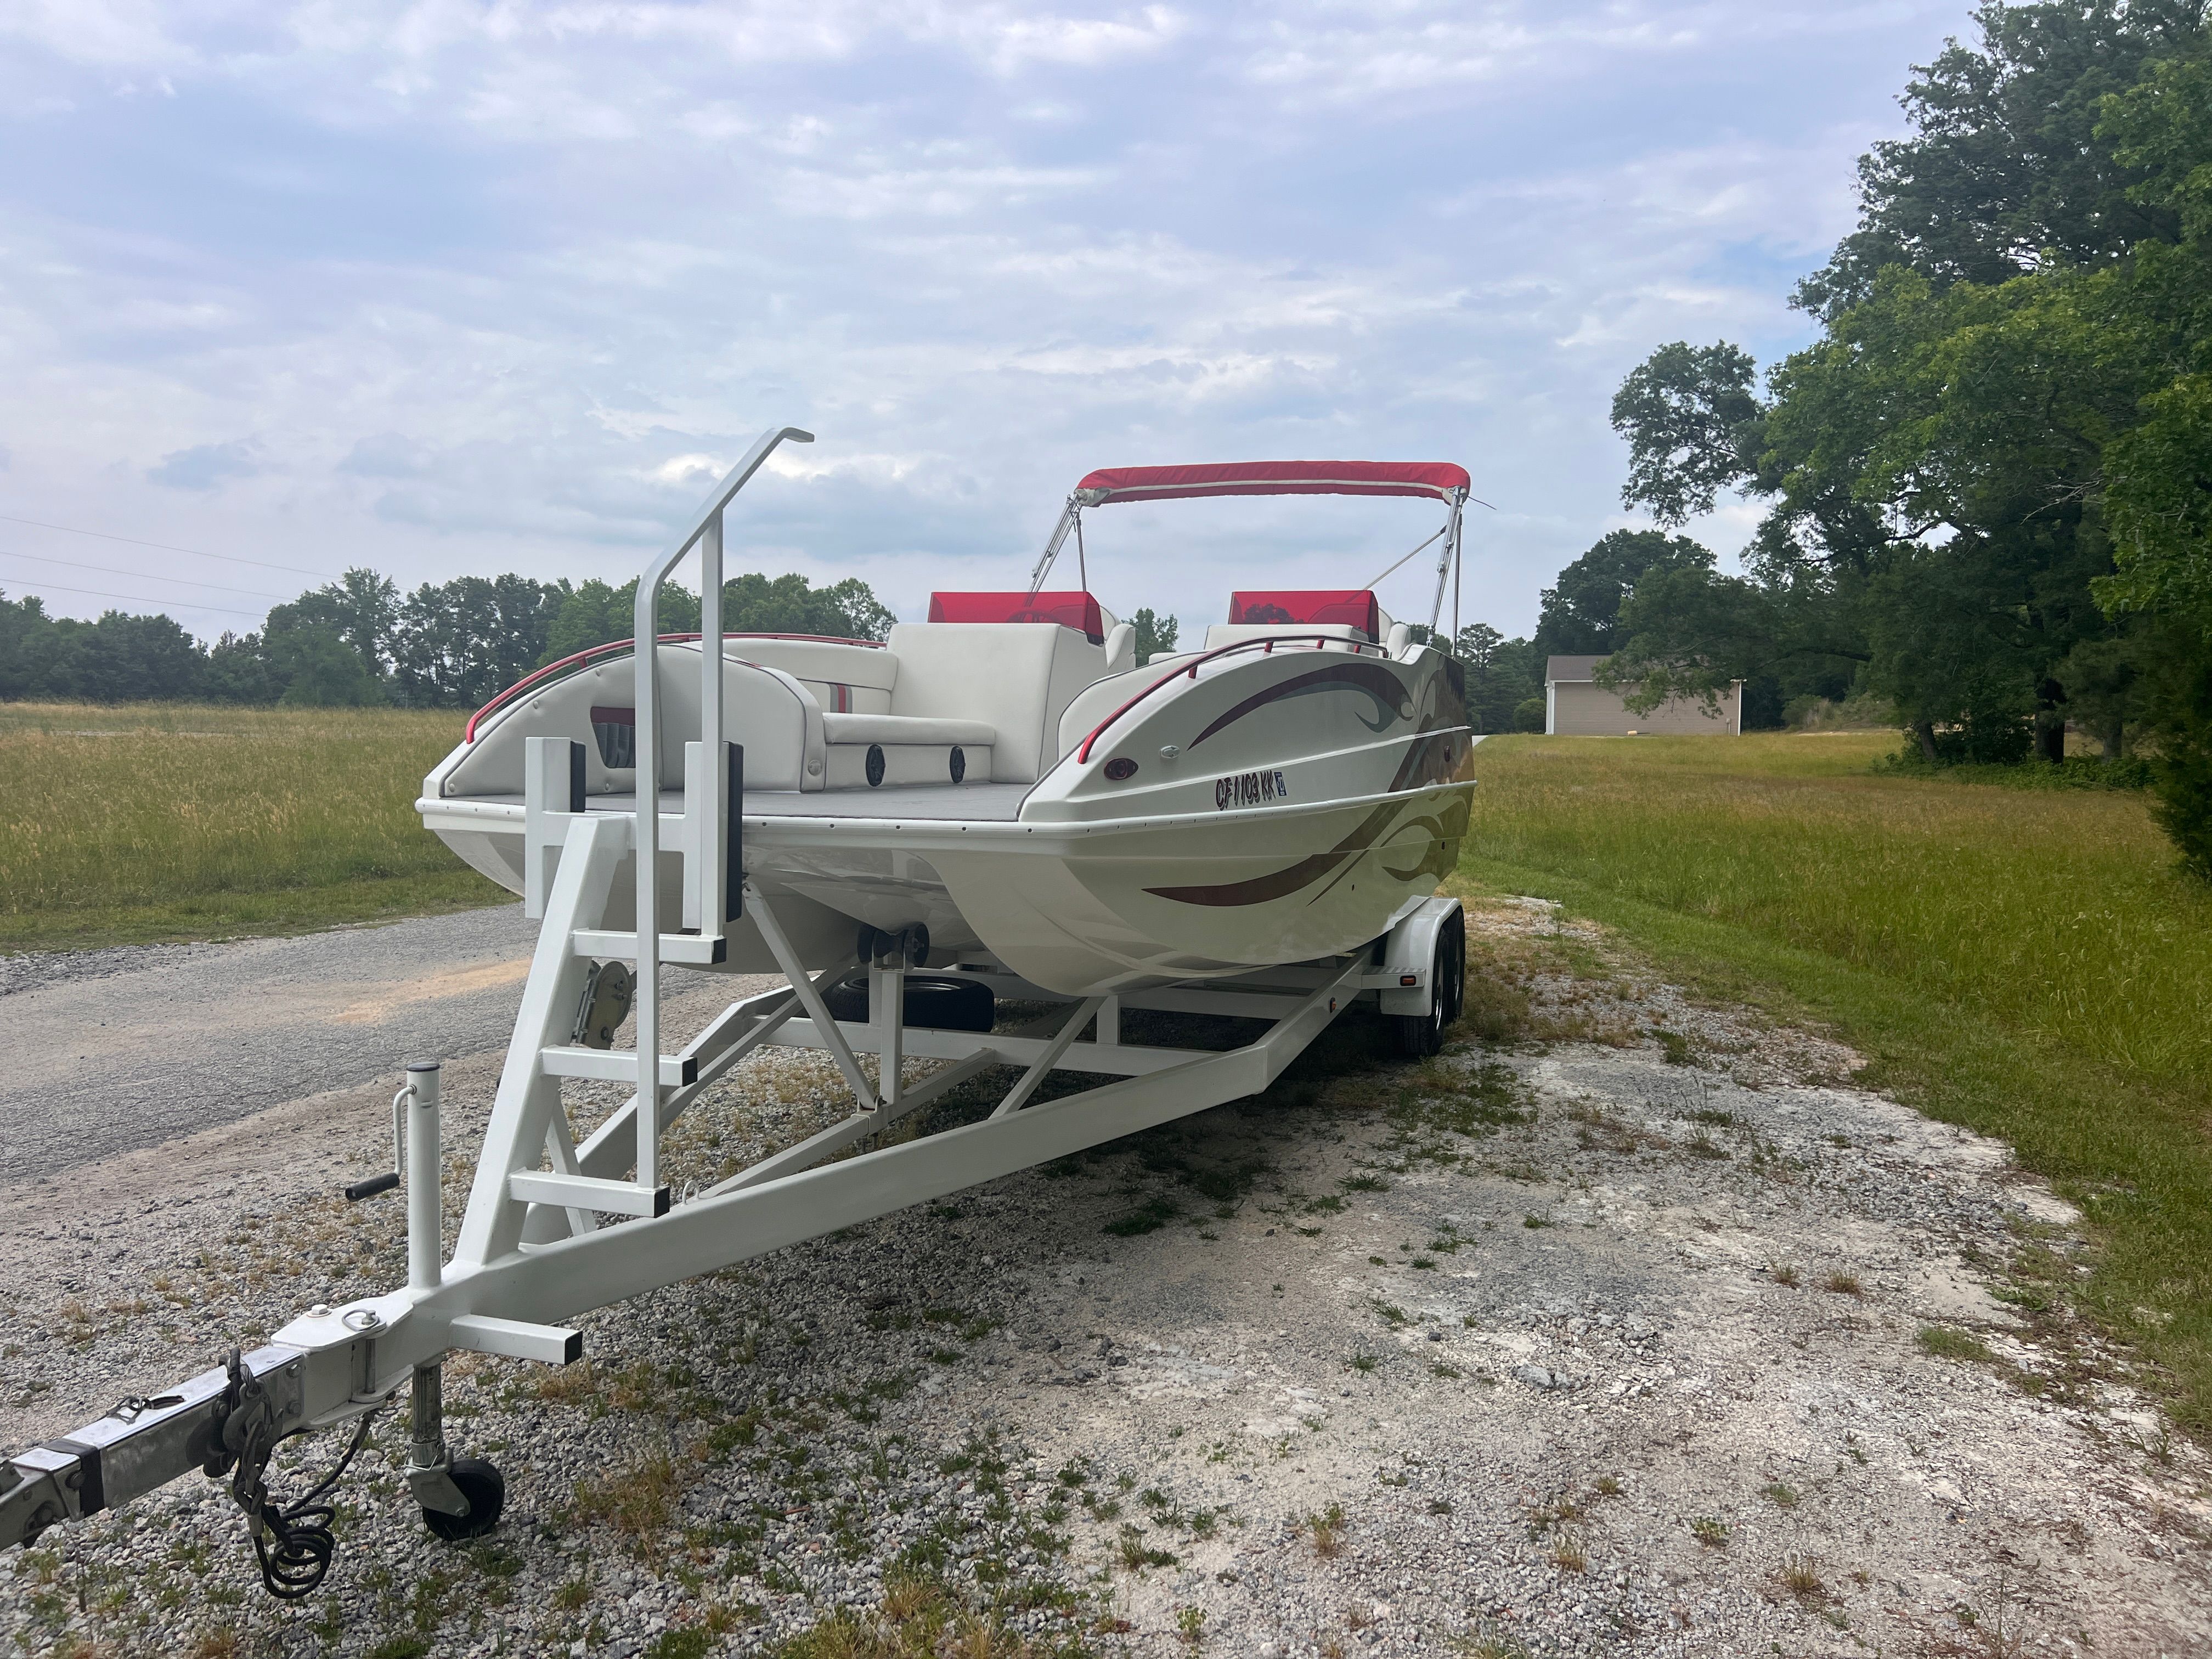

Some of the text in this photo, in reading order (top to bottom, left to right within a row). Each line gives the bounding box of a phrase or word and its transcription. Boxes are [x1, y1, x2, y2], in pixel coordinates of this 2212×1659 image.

[1216, 769, 1276, 811] CF 1103 KK
